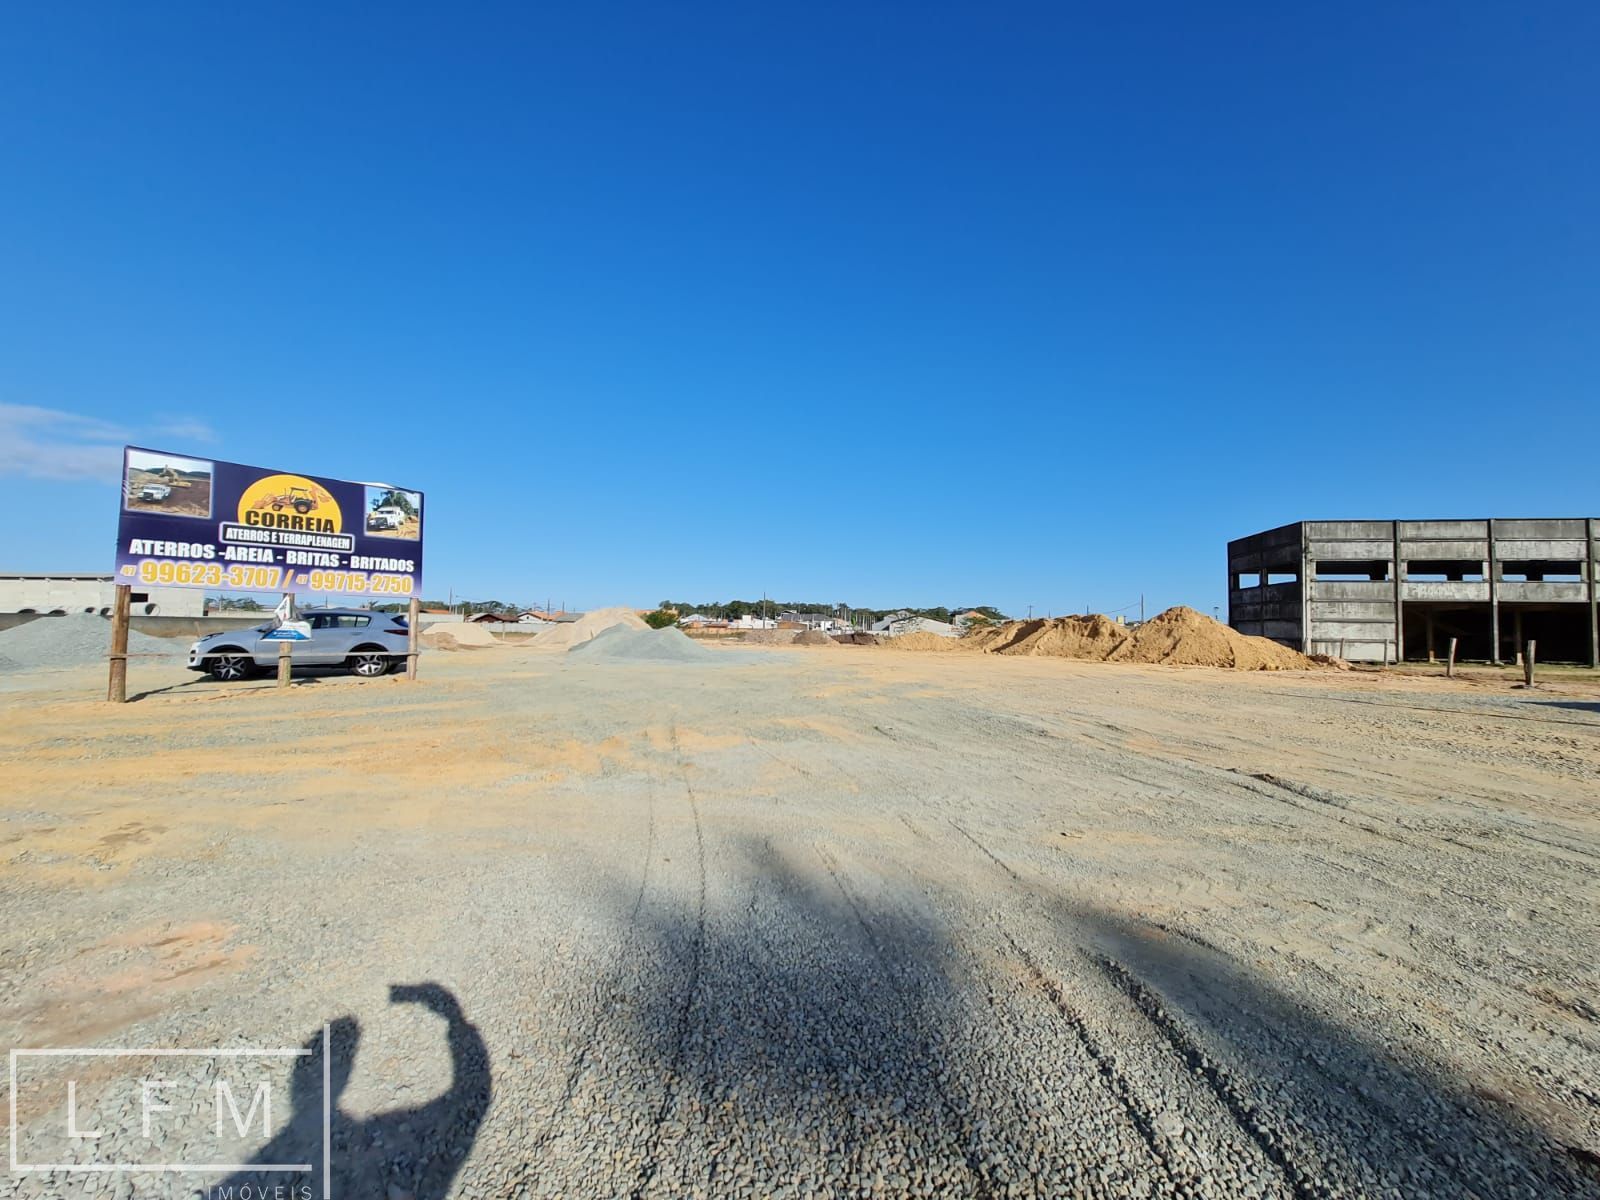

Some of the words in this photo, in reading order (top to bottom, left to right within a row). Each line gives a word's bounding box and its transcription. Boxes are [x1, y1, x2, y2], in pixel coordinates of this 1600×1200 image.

[245, 510, 335, 534] CORREIA
[225, 527, 270, 543] ATERROS
[271, 531, 278, 543] E
[278, 532, 350, 549] TERRAPLENAGEM
[129, 539, 216, 559] ATERROS
[286, 550, 340, 567] BRITAS
[350, 556, 415, 572] BRITADOS
[141, 560, 280, 588] 99623-3707
[311, 571, 412, 594] 99715-2750
